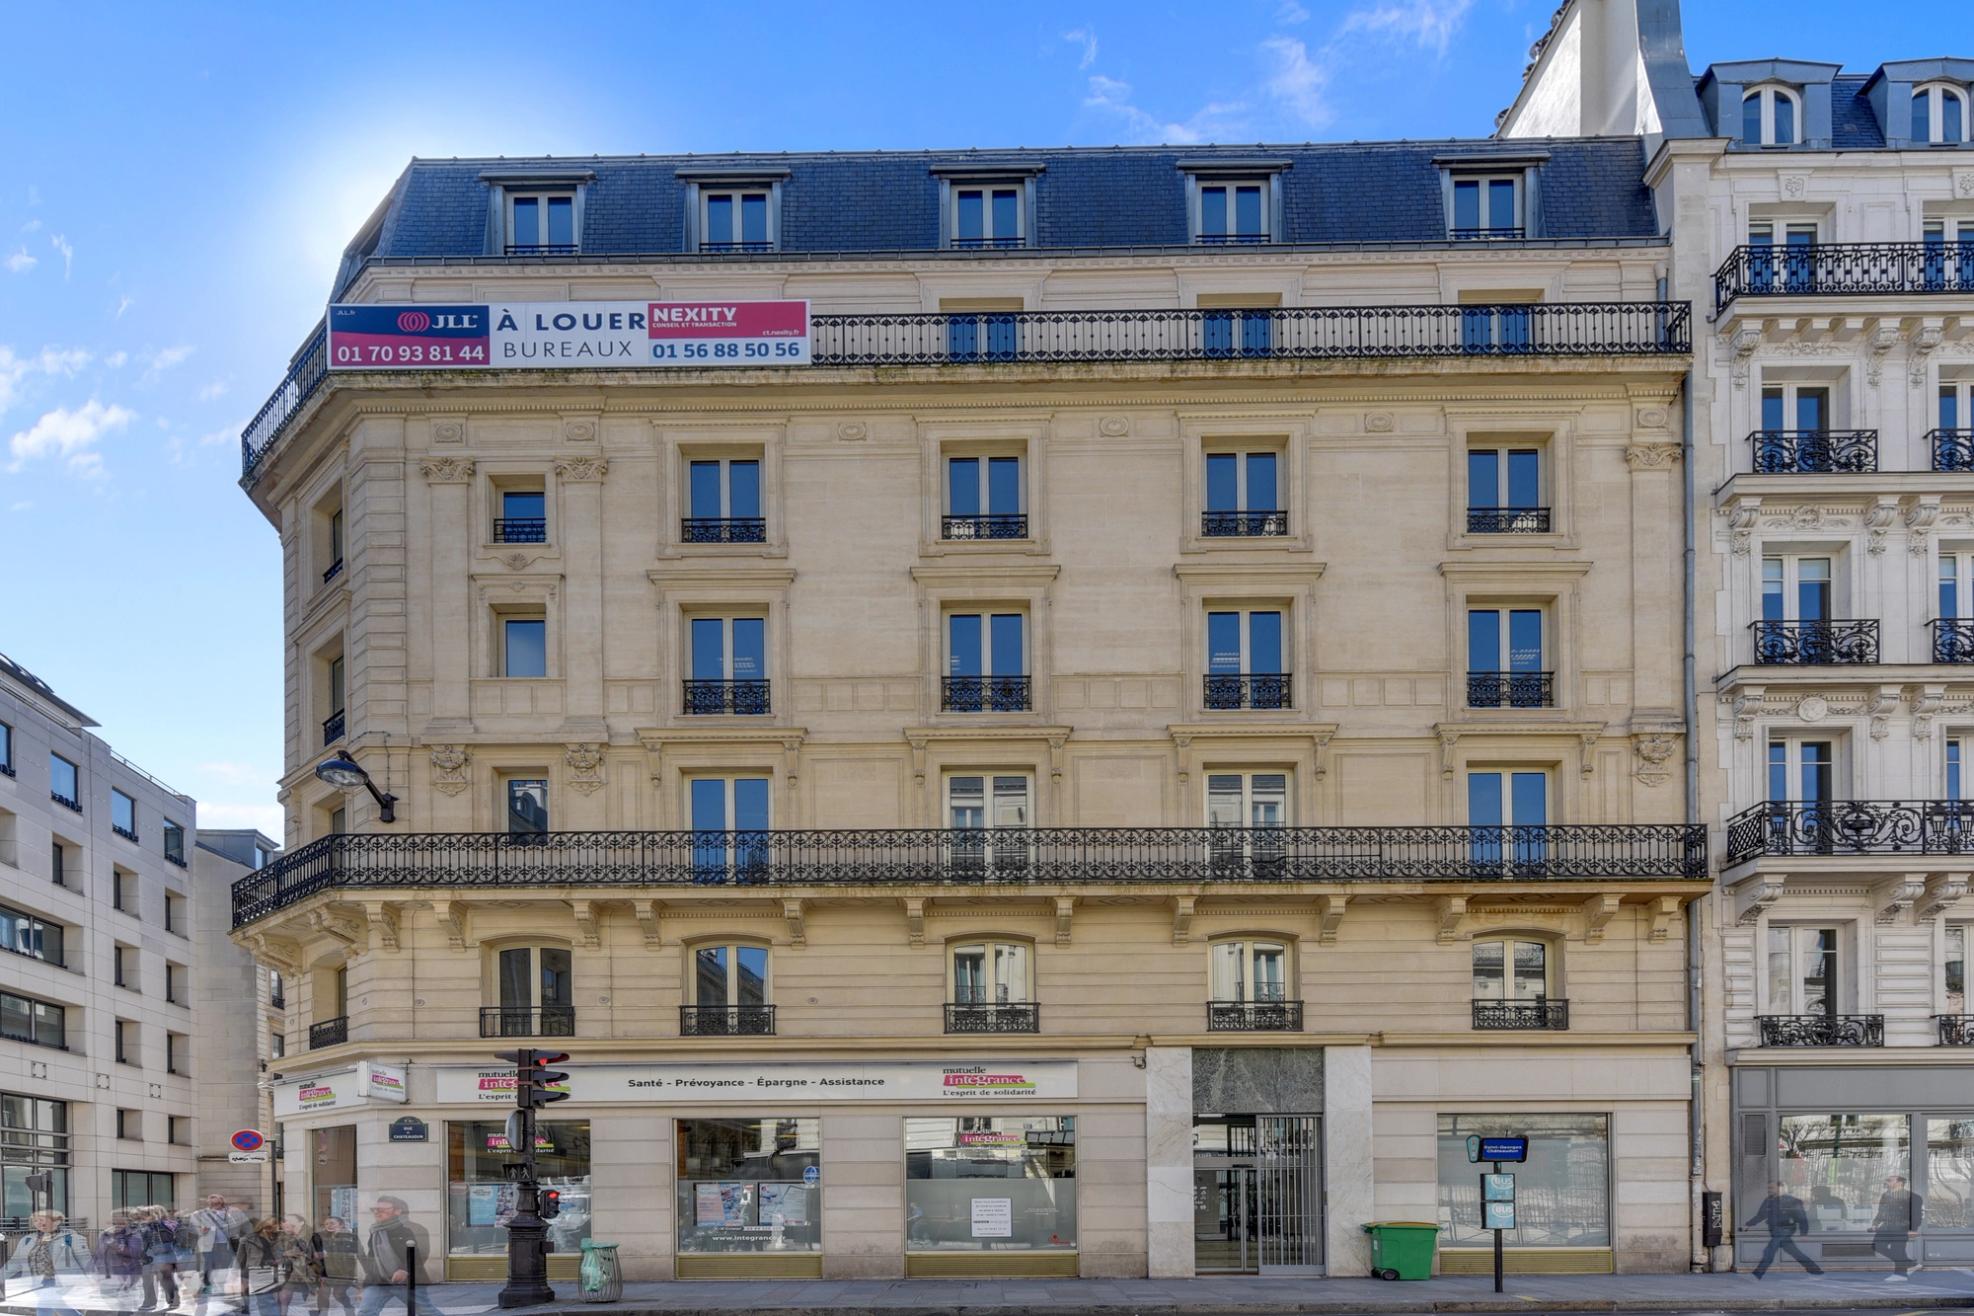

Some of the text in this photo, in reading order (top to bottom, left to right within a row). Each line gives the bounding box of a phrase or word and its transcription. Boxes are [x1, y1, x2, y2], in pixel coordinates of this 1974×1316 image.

[432, 315, 478, 329] JLL
[496, 308, 646, 331] À LOUER
[653, 307, 737, 322] NEXITY
[338, 345, 485, 362] 01 70 93 81 44
[504, 341, 632, 358] BUREAUX
[652, 342, 800, 359] 01 56 88 50 56
[943, 1066, 986, 1074] mutuelle
[628, 1078, 663, 1087] Santé
[675, 1078, 745, 1088] Prévoyance
[757, 1076, 808, 1088] Épargne
[819, 1077, 885, 1086] Assistance
